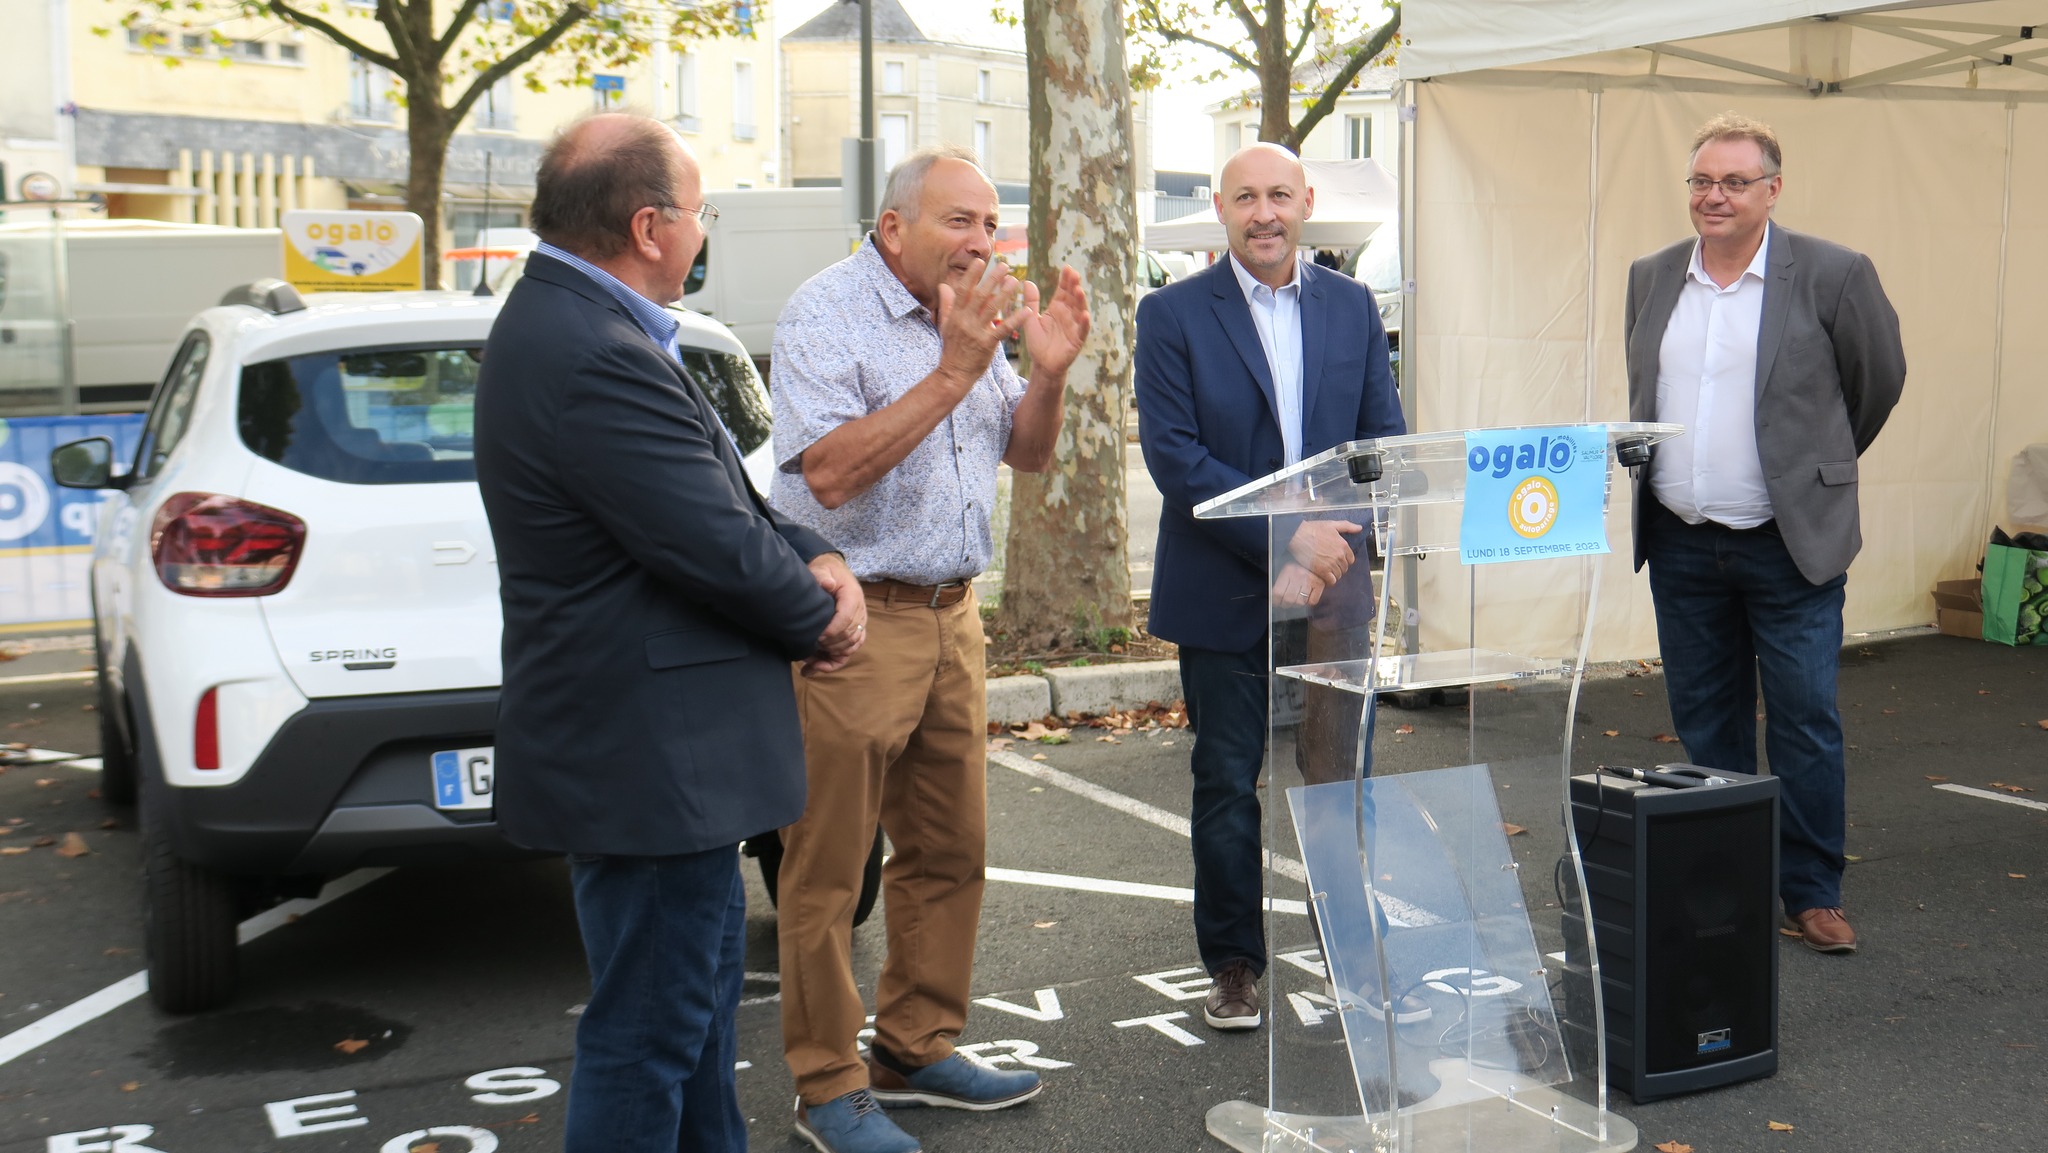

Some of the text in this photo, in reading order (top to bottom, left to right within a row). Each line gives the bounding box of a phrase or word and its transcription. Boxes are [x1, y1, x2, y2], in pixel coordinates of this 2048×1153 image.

[306, 219, 393, 246] ogalo
[1468, 437, 1570, 479] ogalo
[1516, 480, 1542, 501] ogalo
[1467, 541, 1600, 559] LUNDI 18 SEPTEMBRE 2023
[309, 648, 397, 662] SPRING
[445, 784, 455, 797] F
